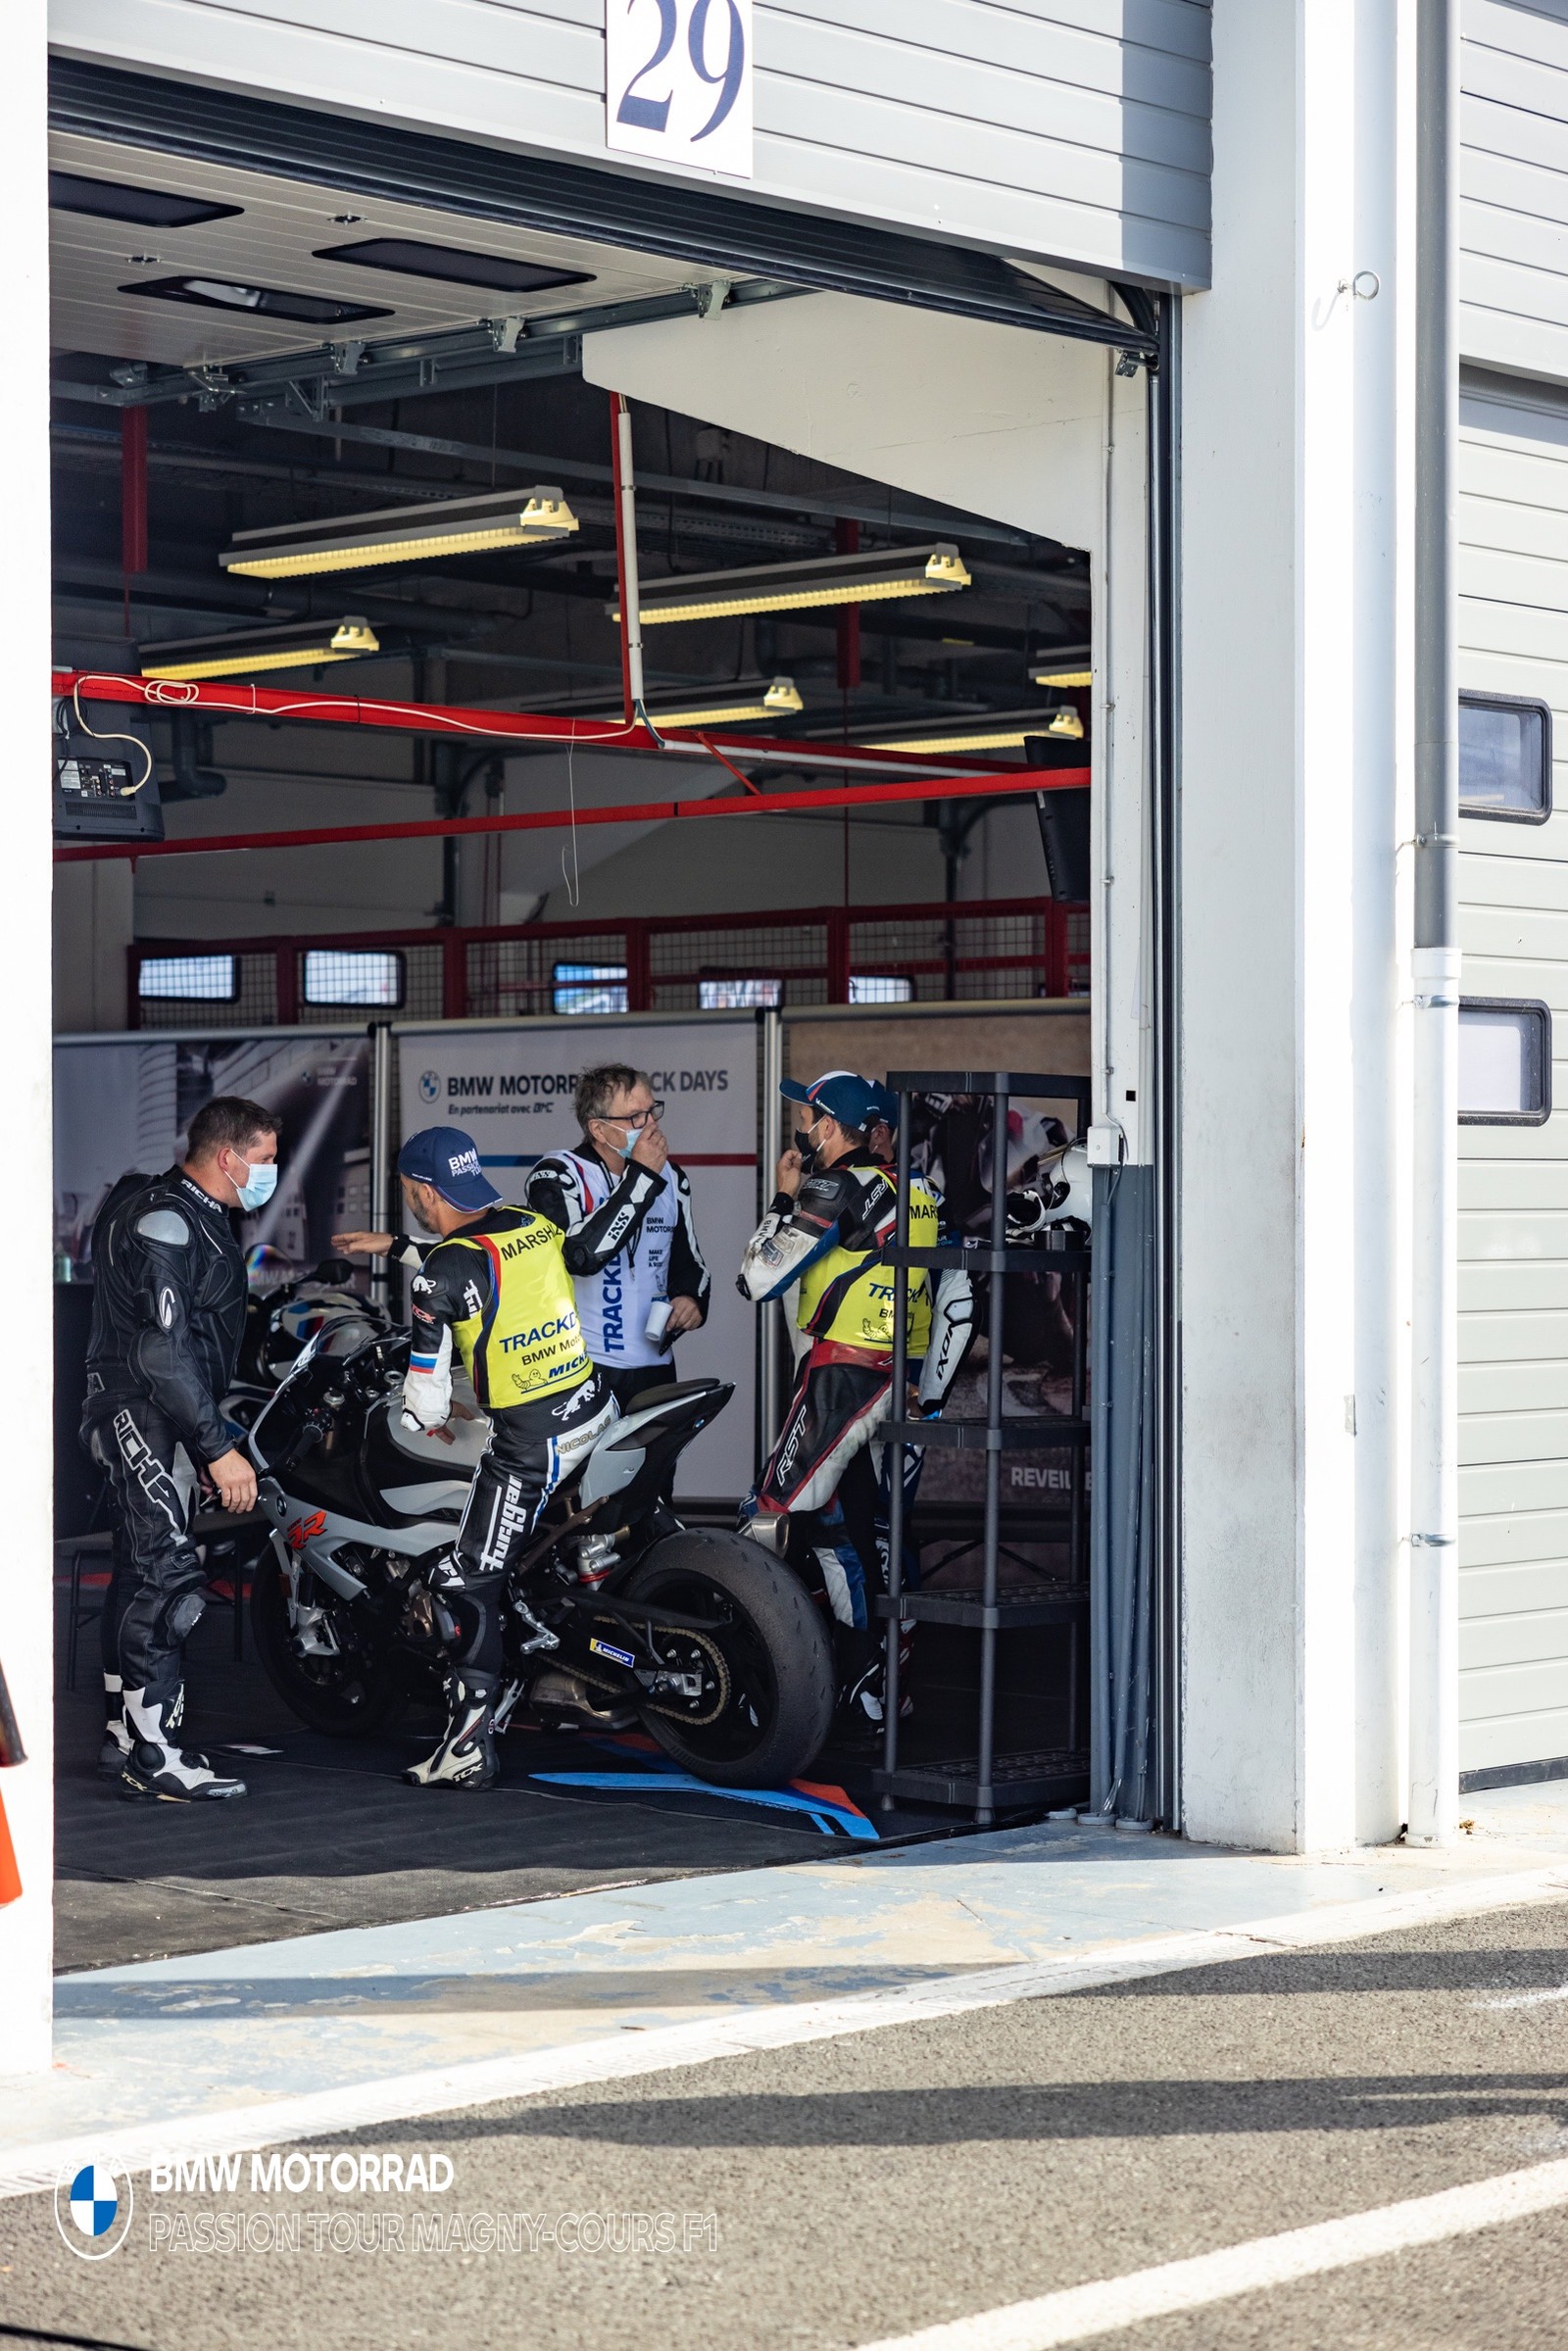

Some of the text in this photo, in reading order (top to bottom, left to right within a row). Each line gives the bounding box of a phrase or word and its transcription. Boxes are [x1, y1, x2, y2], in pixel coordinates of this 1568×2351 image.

[616, 0, 745, 142] 29
[448, 1076, 494, 1096] BMW
[680, 1070, 729, 1091] DAYS
[448, 1103, 459, 1115] En
[460, 1102, 509, 1117] partenariat
[448, 1148, 478, 1170] BMW
[180, 1178, 223, 1214] RICHA
[521, 1345, 556, 1366] BMW
[776, 1404, 807, 1487] RST
[603, 1647, 630, 1663] MICHELIN
